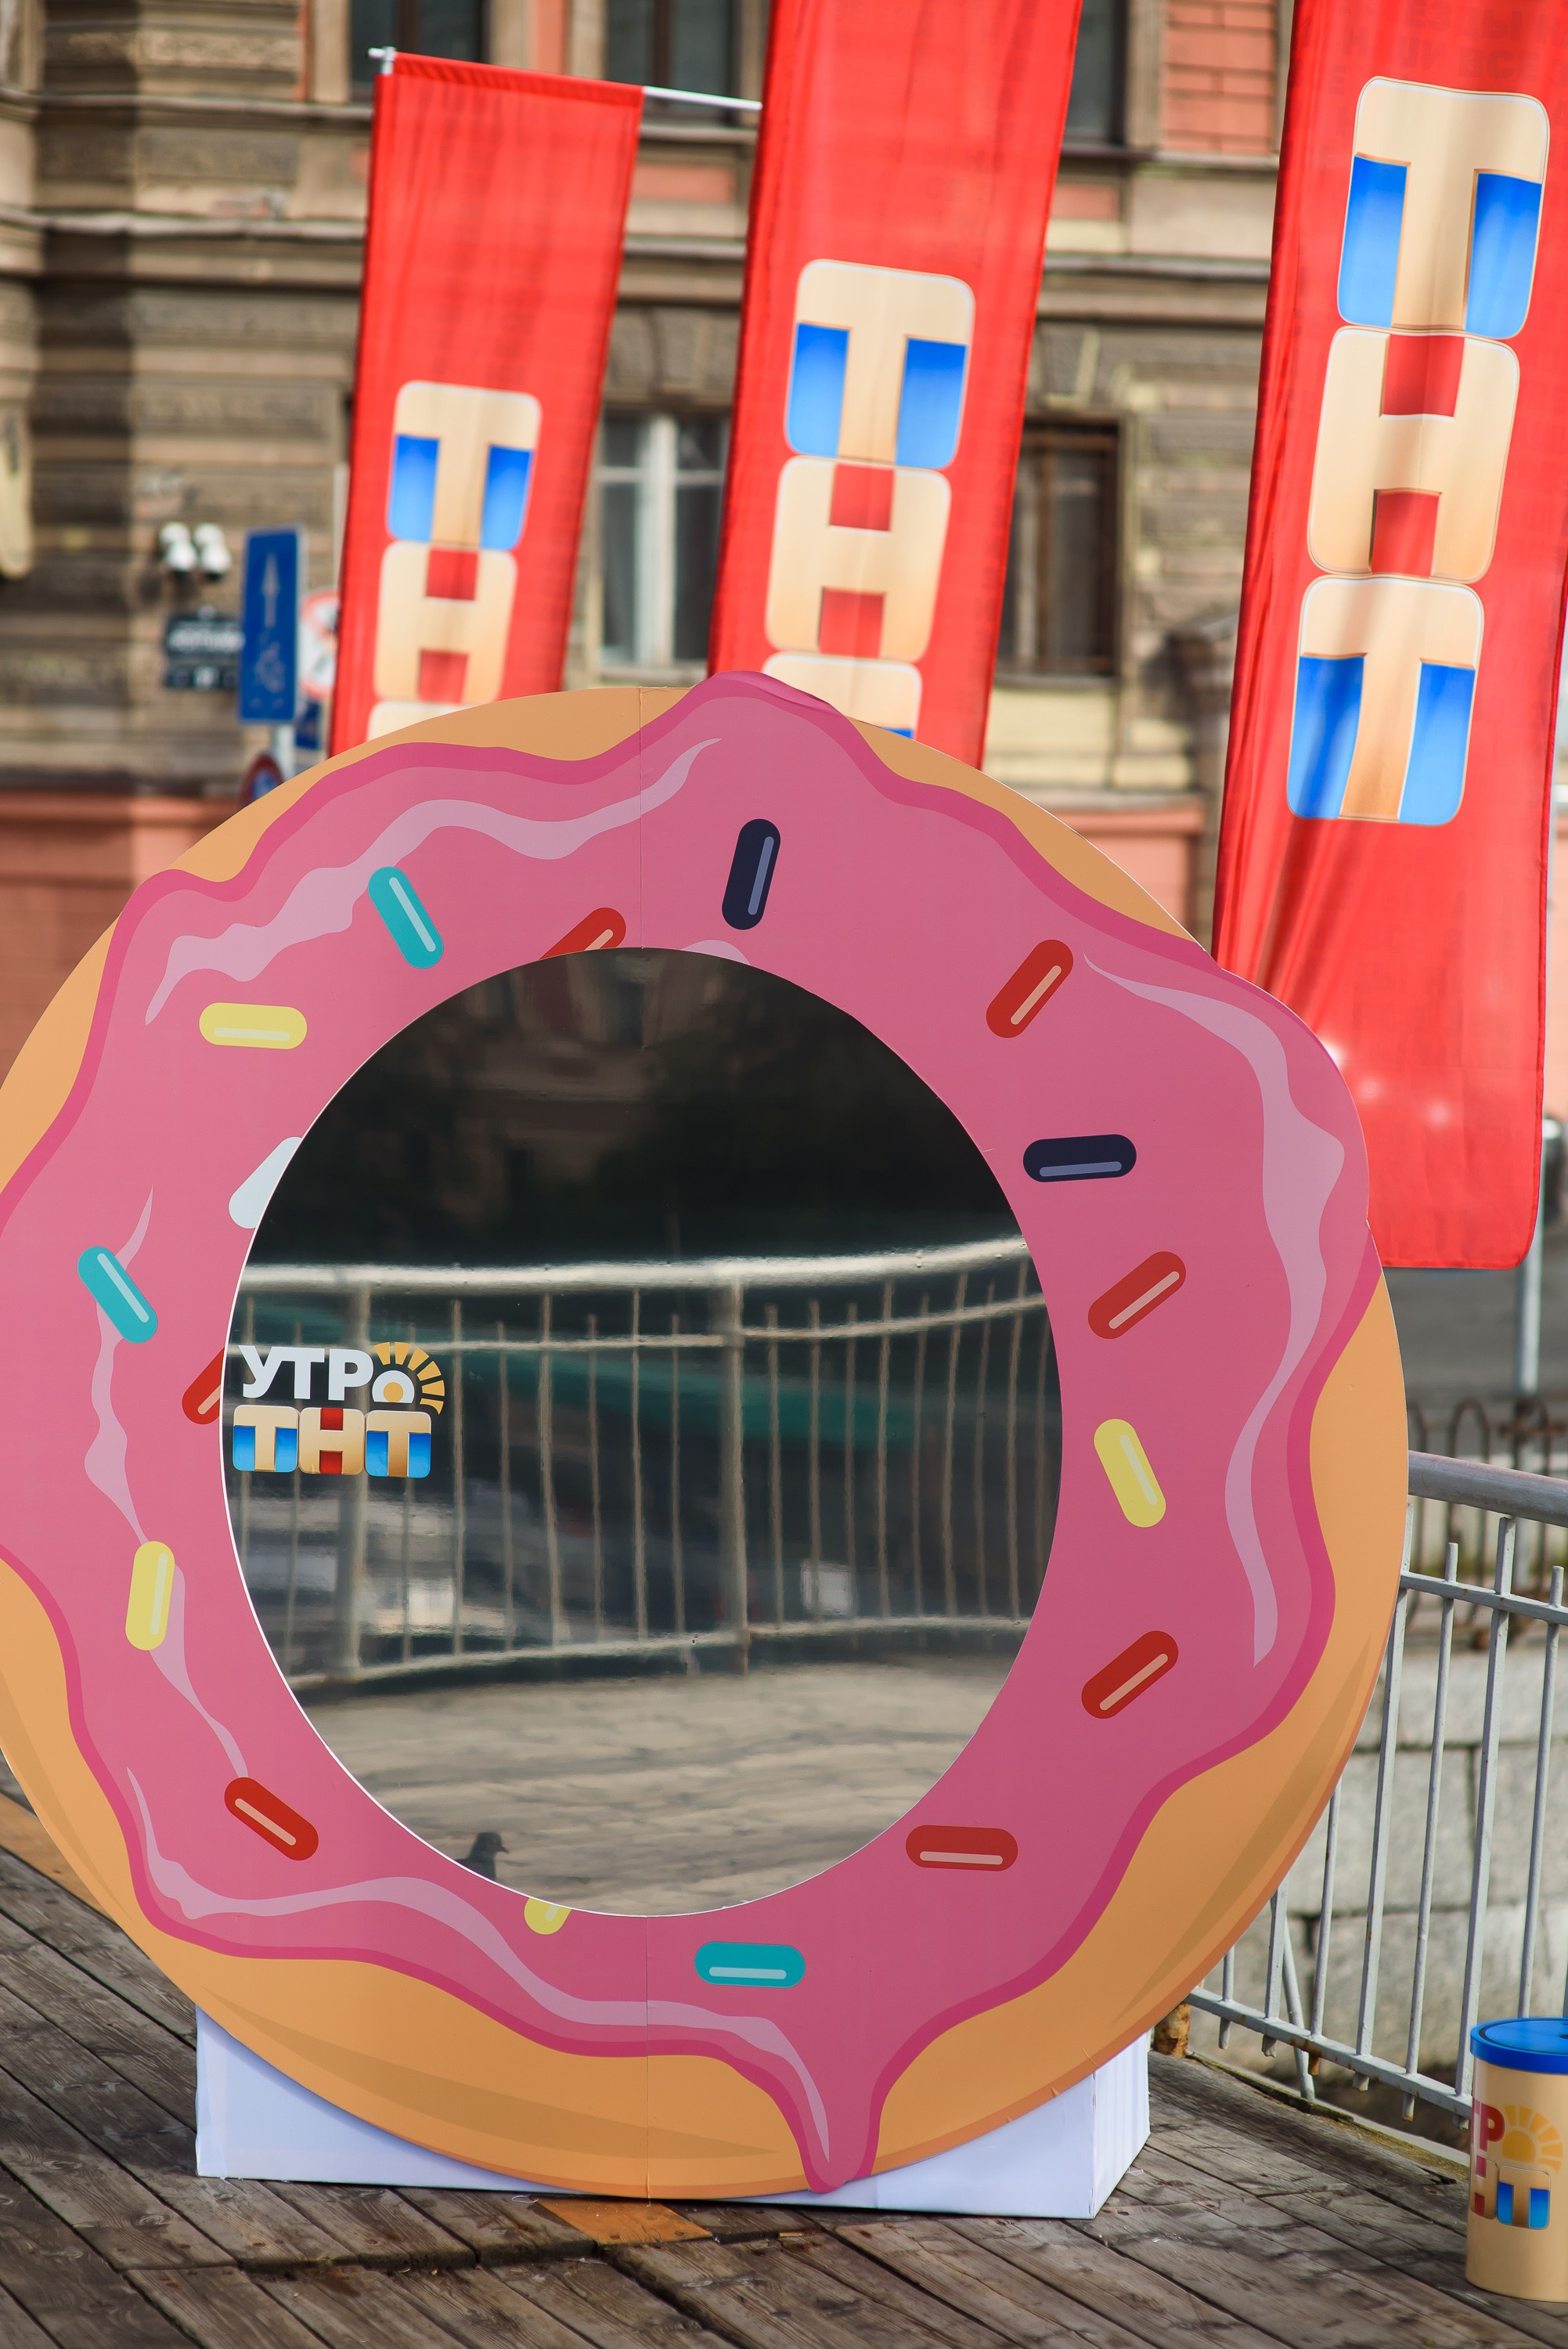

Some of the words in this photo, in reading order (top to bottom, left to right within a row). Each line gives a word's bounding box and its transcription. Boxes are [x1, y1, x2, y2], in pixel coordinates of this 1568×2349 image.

[1286, 76, 1549, 825] ТНТ
[368, 380, 542, 742] ТН
[232, 1404, 431, 1478] ТНТ
[237, 1344, 416, 1404] УТРО
